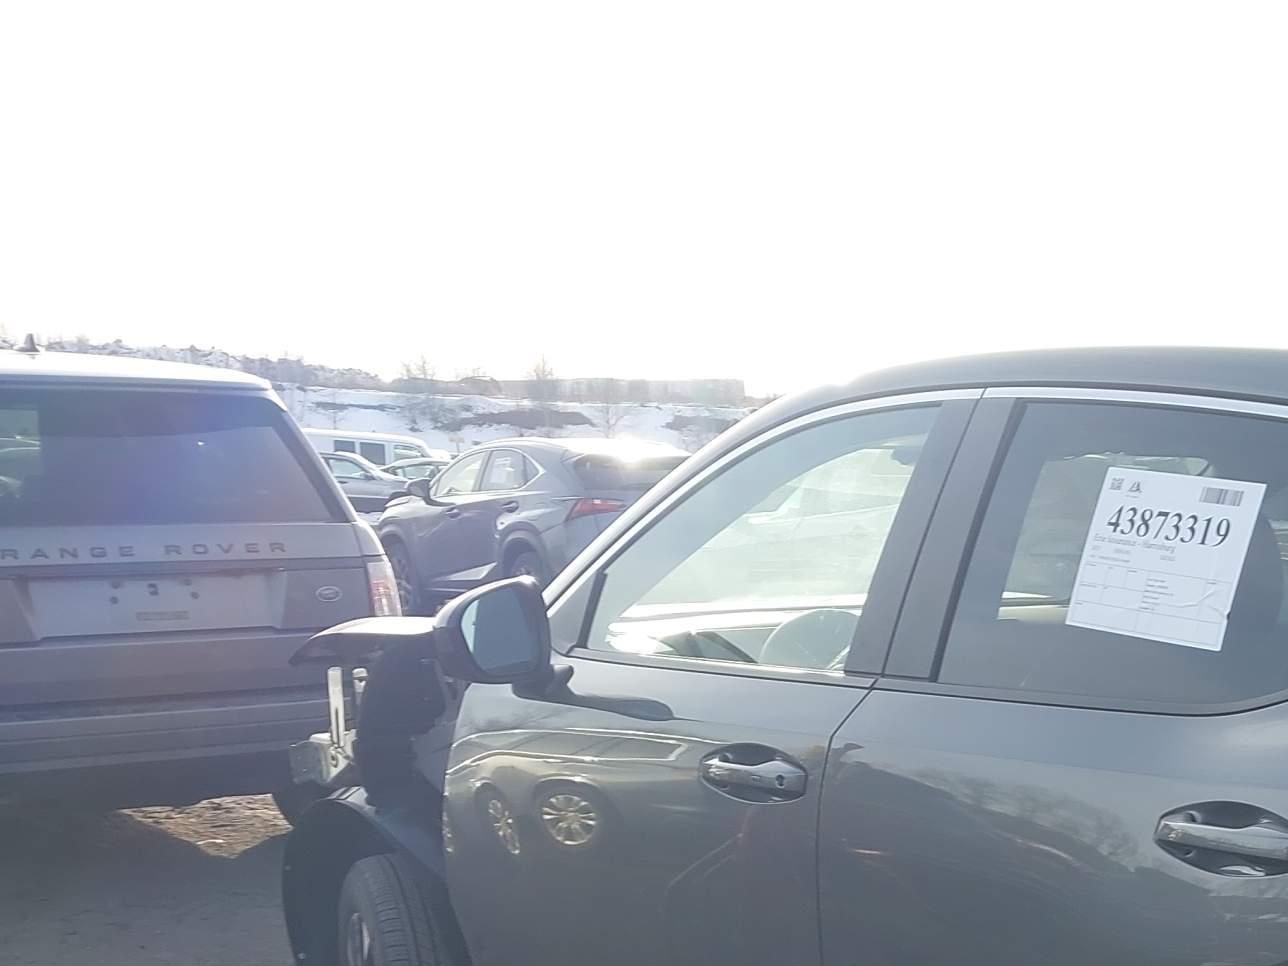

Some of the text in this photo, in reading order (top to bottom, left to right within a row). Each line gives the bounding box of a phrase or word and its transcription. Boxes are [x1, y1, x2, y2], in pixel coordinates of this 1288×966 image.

[1106, 504, 1231, 548] 43873319
[0, 541, 288, 561] RANGE ROVER
